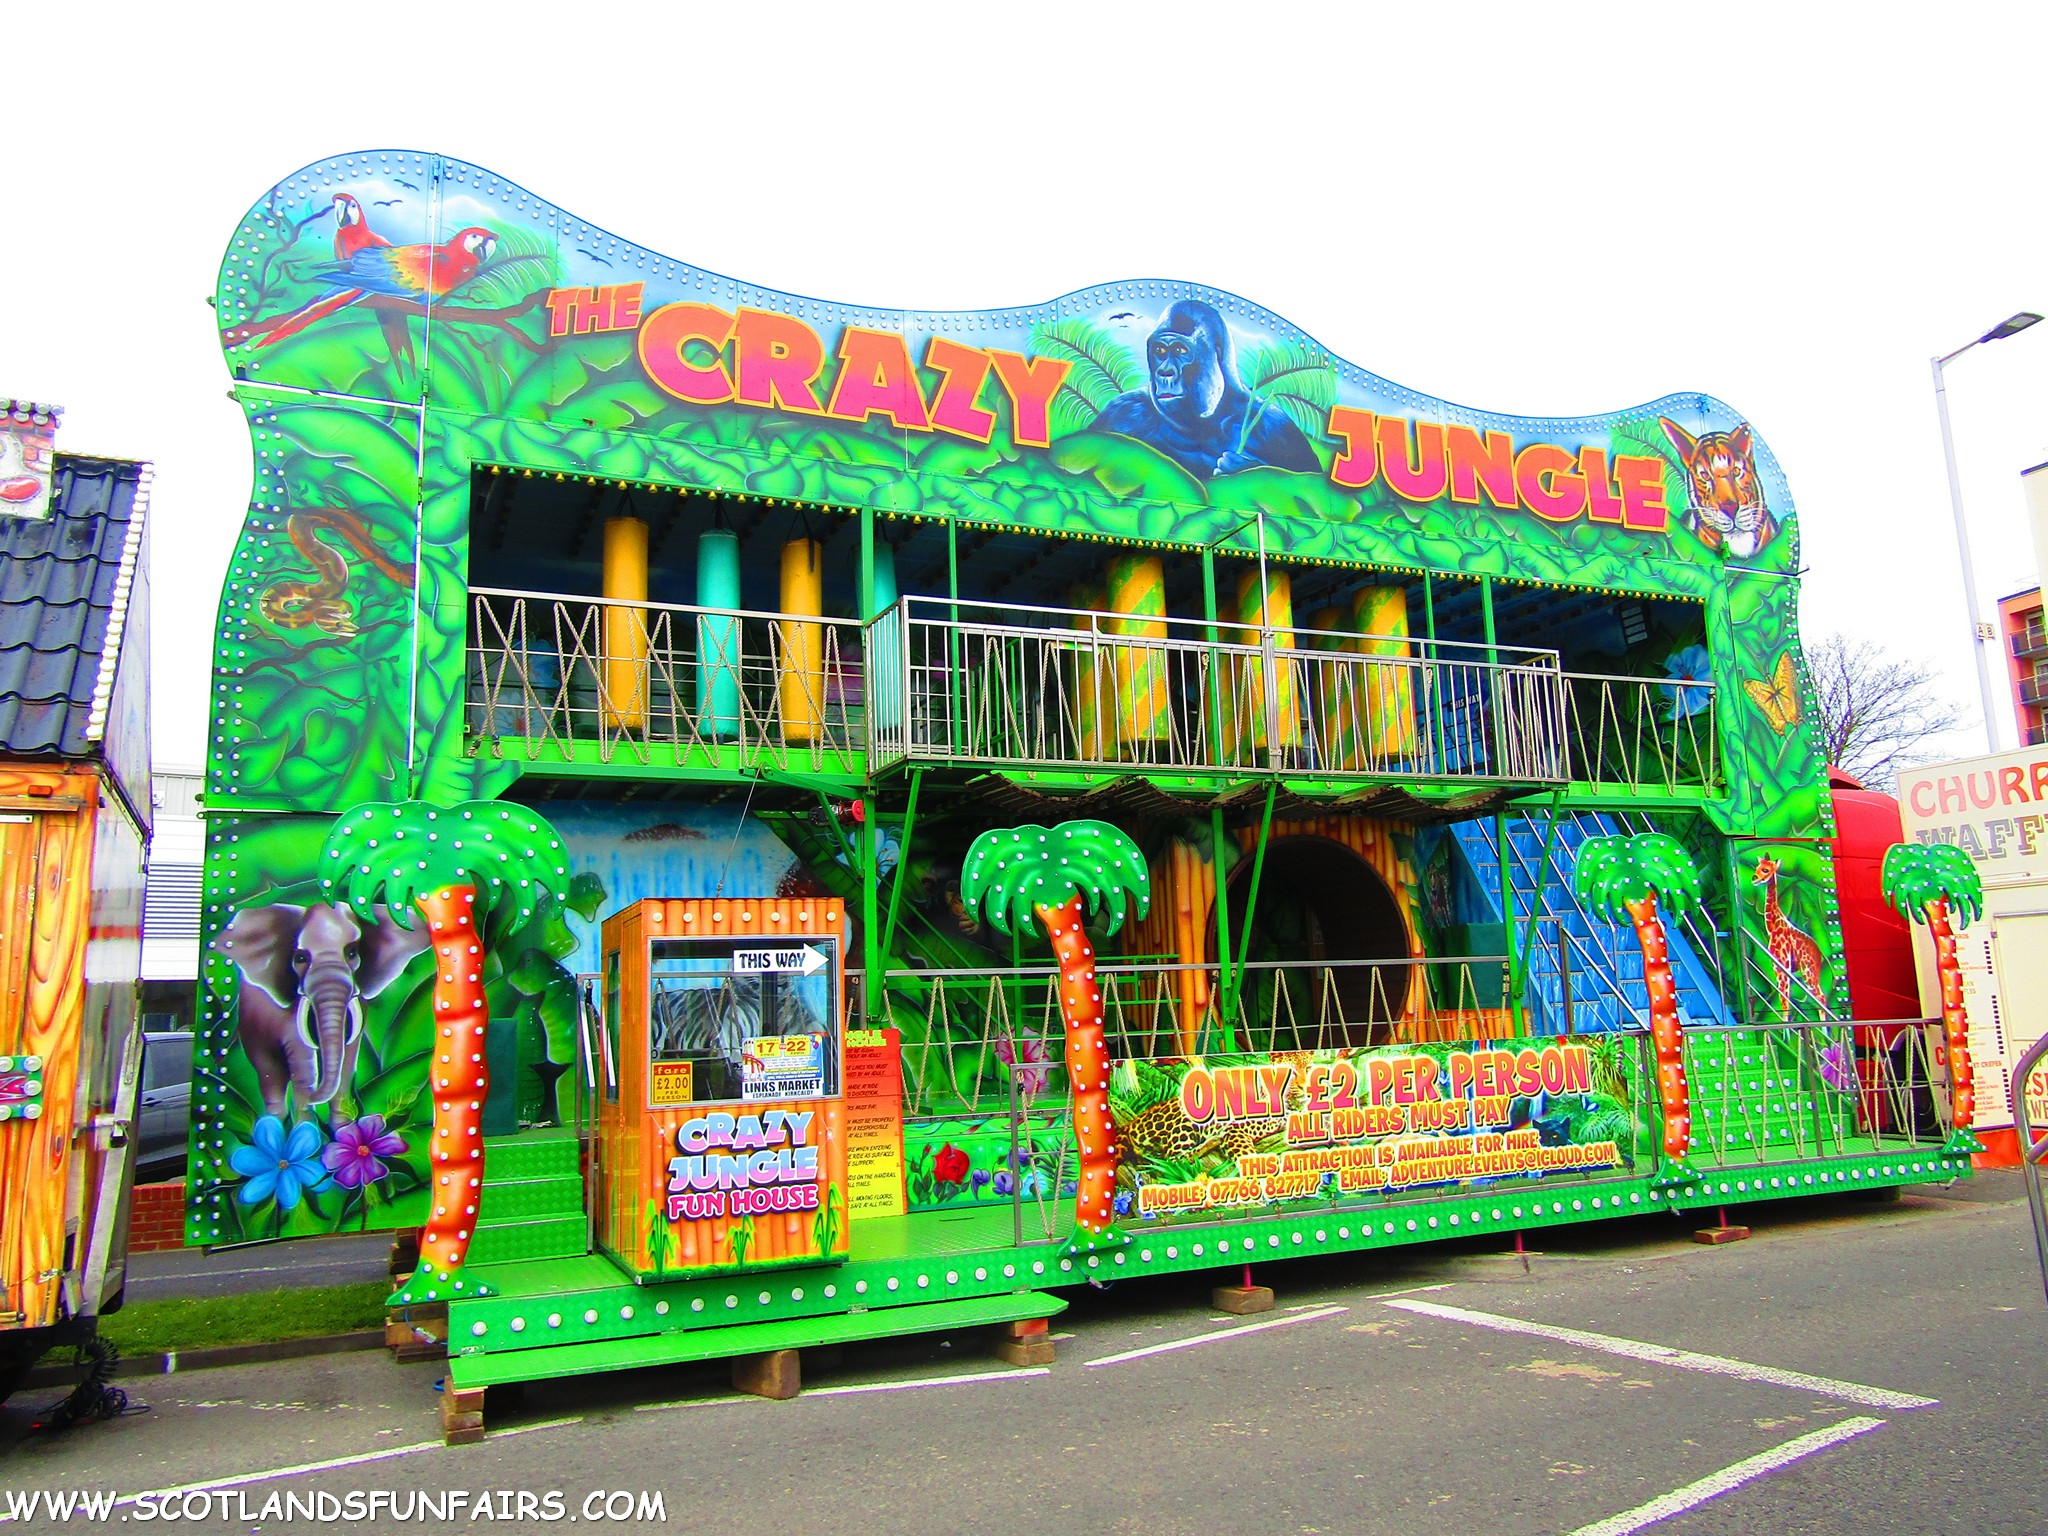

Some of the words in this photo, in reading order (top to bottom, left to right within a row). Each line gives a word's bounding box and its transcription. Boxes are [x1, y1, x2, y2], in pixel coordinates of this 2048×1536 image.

[546, 281, 646, 336] THE
[638, 302, 1073, 448] CRAZY
[1328, 405, 1669, 532] JUNGLE
[1916, 813, 2048, 861] WAFF
[739, 953, 770, 969] THIS
[775, 953, 806, 968] WAY
[757, 1042, 775, 1053] 17
[787, 1041, 806, 1052] 22
[656, 1077, 688, 1090] £2.00
[657, 1065, 688, 1075] fare
[745, 1081, 775, 1093] LINKS
[778, 1079, 820, 1091] MARKET
[1182, 1067, 1291, 1122] ONLY
[1306, 1061, 1357, 1111] £2
[1369, 1057, 1439, 1105] PER
[1450, 1048, 1591, 1099] PERSON
[753, 1091, 781, 1099] ESPLANADE
[678, 1110, 815, 1152] CRAZY
[1287, 1113, 1325, 1143] ALL
[1333, 1106, 1405, 1138] RIDERS
[1410, 1100, 1468, 1130] MUST
[1474, 1098, 1510, 1124] PAY
[668, 1146, 819, 1192] JUNGLE
[1240, 1156, 1279, 1177] THIS
[1283, 1147, 1374, 1173] ATTRACTION
[1378, 1145, 1393, 1164] IS
[1398, 1136, 1472, 1161] AVAILABLE
[1476, 1134, 1502, 1153] FOR
[1506, 1131, 1538, 1150] HIRE
[668, 1190, 726, 1219] FUN
[731, 1184, 819, 1214] HOUSE
[1142, 1186, 1205, 1210] MOBILE:
[1209, 1179, 1261, 1201] 07766
[1265, 1173, 1321, 1195] 827717
[1340, 1166, 1388, 1188] EMAIL:
